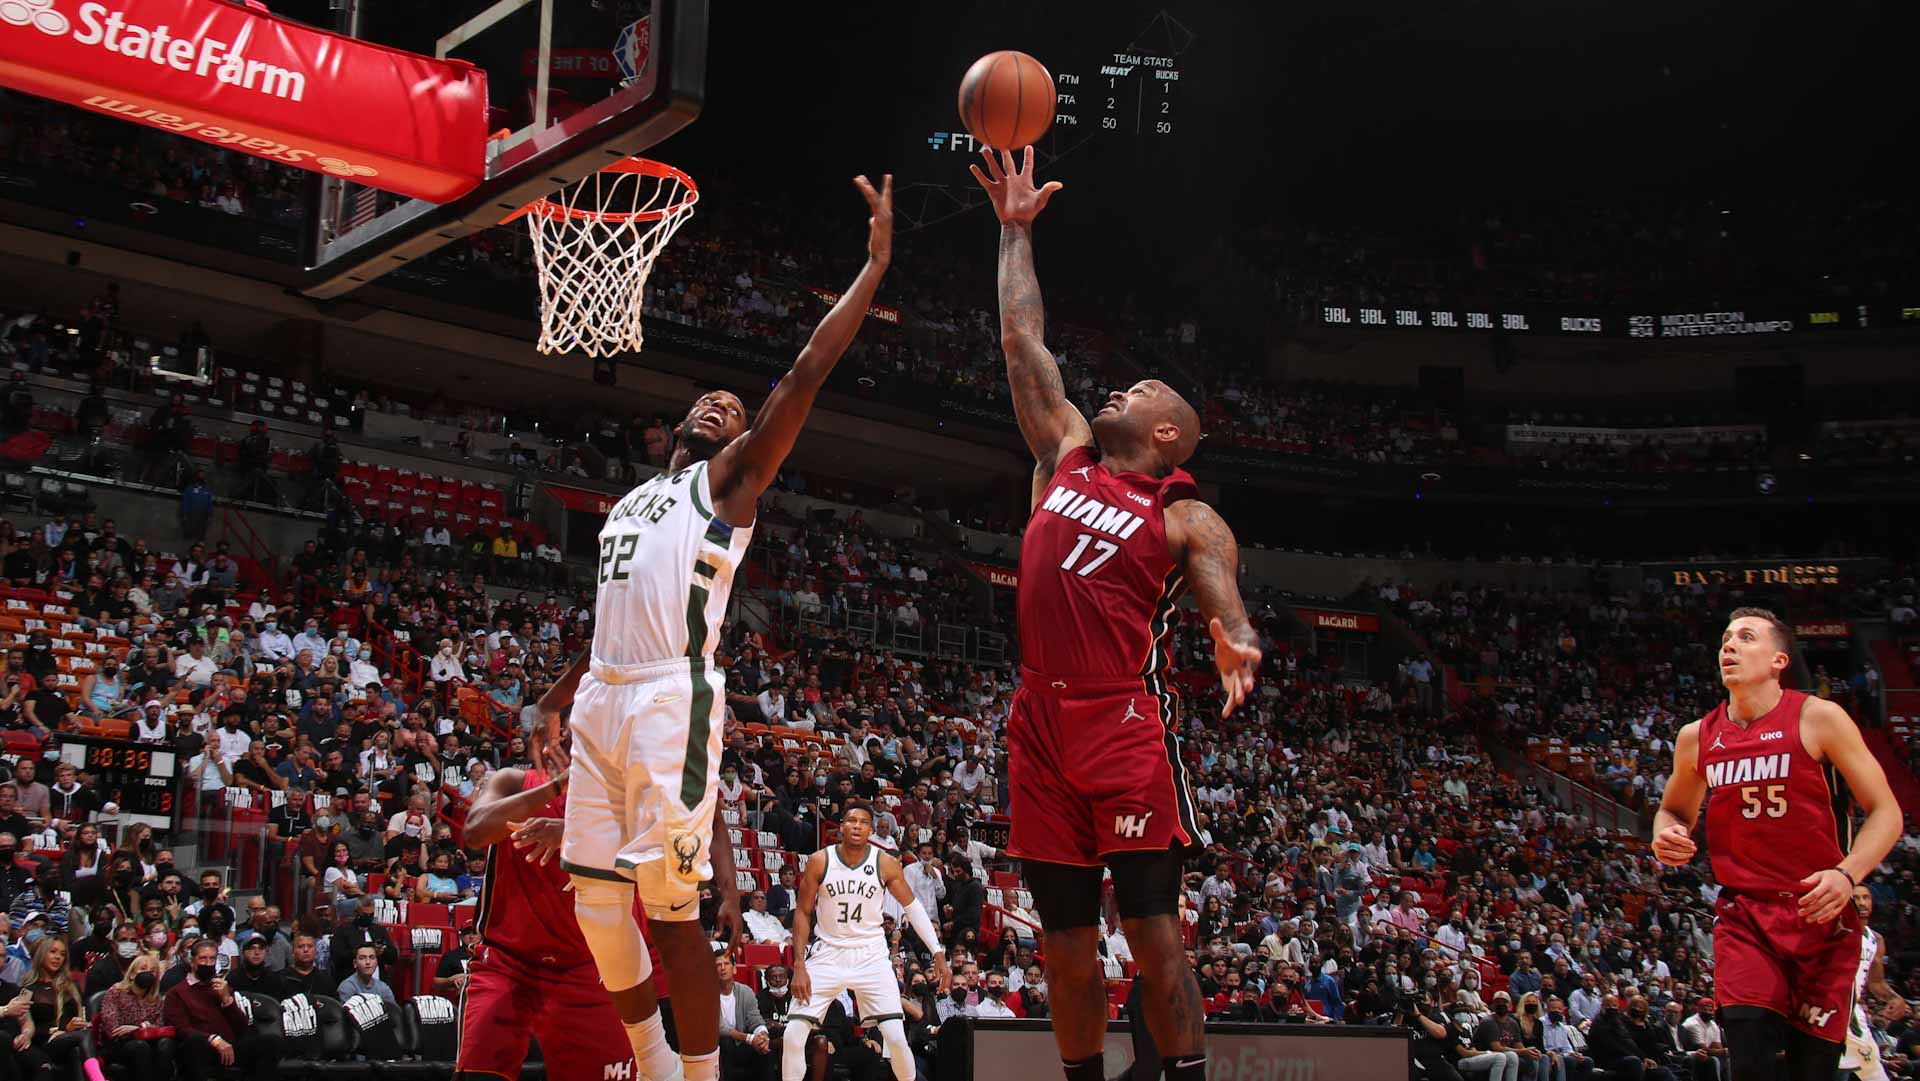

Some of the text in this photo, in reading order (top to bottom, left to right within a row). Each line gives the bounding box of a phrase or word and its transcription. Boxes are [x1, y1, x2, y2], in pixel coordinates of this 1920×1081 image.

[1113, 53, 1174, 68] TEAM STATS
[1100, 65, 1134, 77] HEAT
[1155, 69, 1179, 80] BUCKS
[1058, 73, 1169, 93] FTM 1 1
[1057, 93, 1170, 114] FTA 2 2
[1055, 114, 1171, 133] FT% 50 50
[1324, 307, 1529, 330] JBL JBL JBL JBL JBL JBL
[1560, 316, 1601, 332] BUCKS
[1661, 312, 1745, 326] MIDDLETON
[609, 493, 678, 524] UCKS
[1126, 491, 1151, 507] UKG
[1042, 485, 1146, 541] MIAMI
[600, 535, 640, 584] 22
[1060, 533, 1121, 577] 17
[1760, 731, 1784, 741] UKG
[1706, 753, 1791, 788] MIAMI
[1740, 785, 1788, 819] 55
[826, 880, 877, 900] BUCKS
[837, 902, 863, 924] 34
